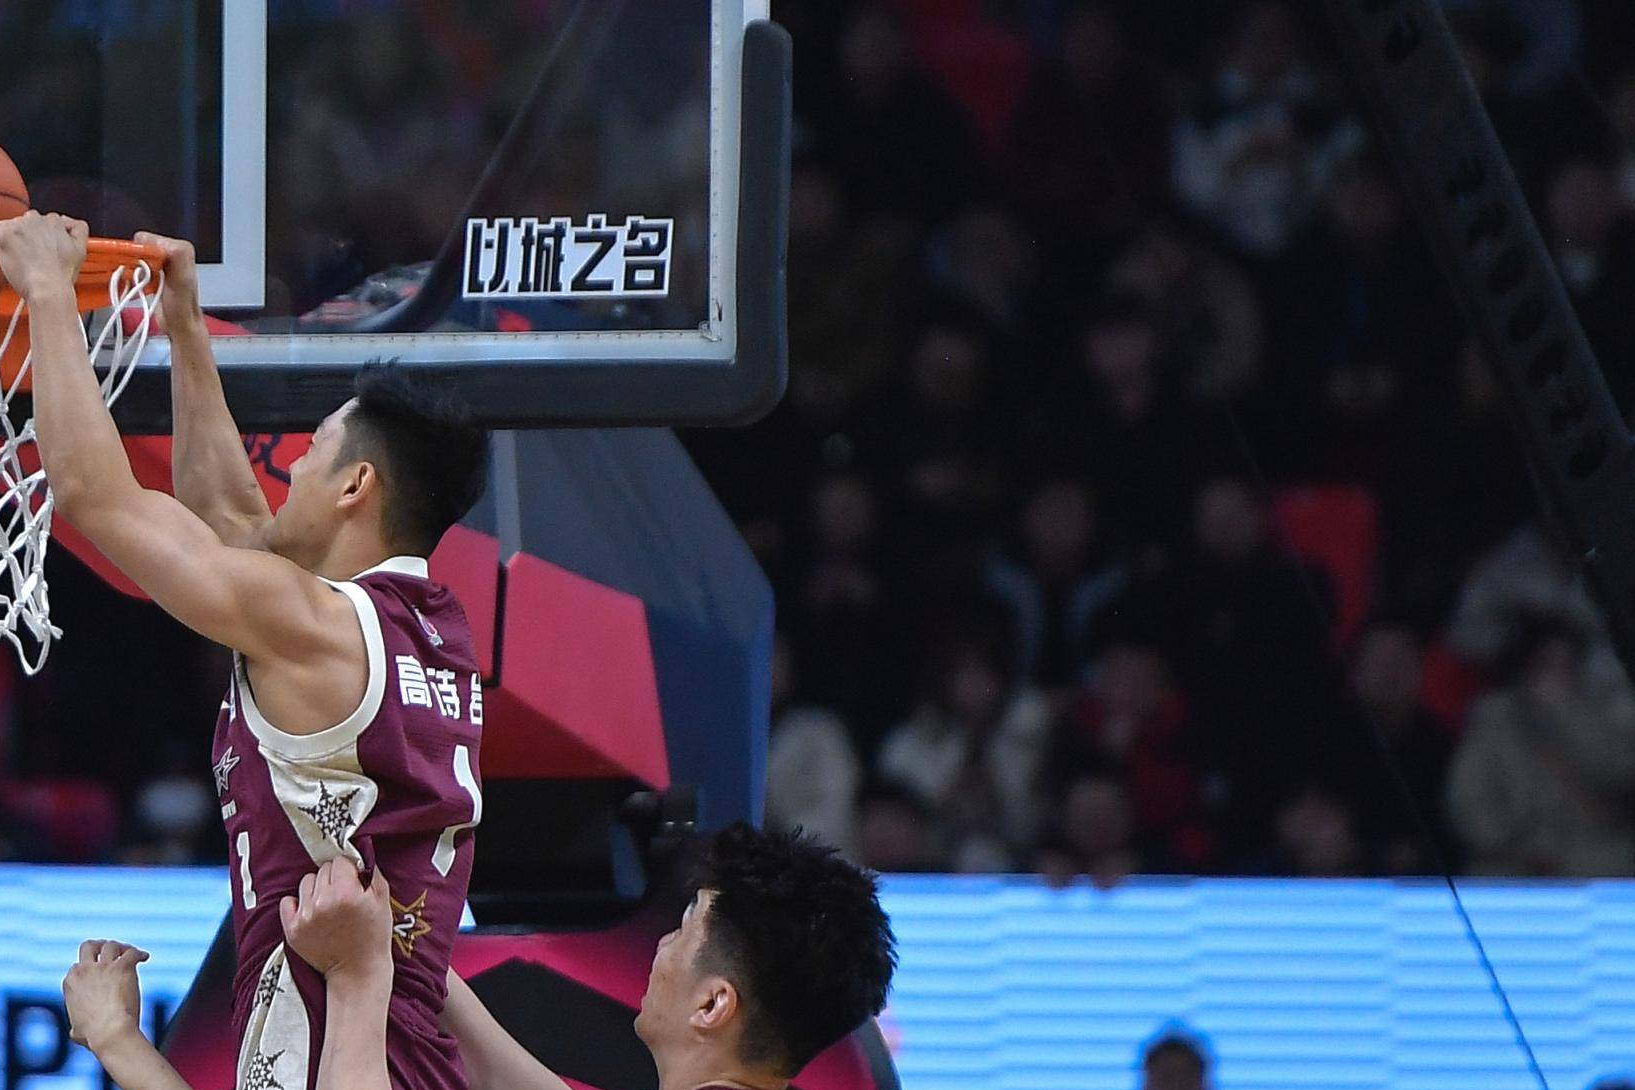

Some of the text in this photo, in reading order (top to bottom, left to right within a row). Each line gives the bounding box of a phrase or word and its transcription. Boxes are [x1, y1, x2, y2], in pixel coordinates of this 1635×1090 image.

[466, 216, 670, 294] 以城之名
[430, 744, 483, 878] 1
[236, 830, 257, 910] 1
[393, 913, 416, 937] 2
